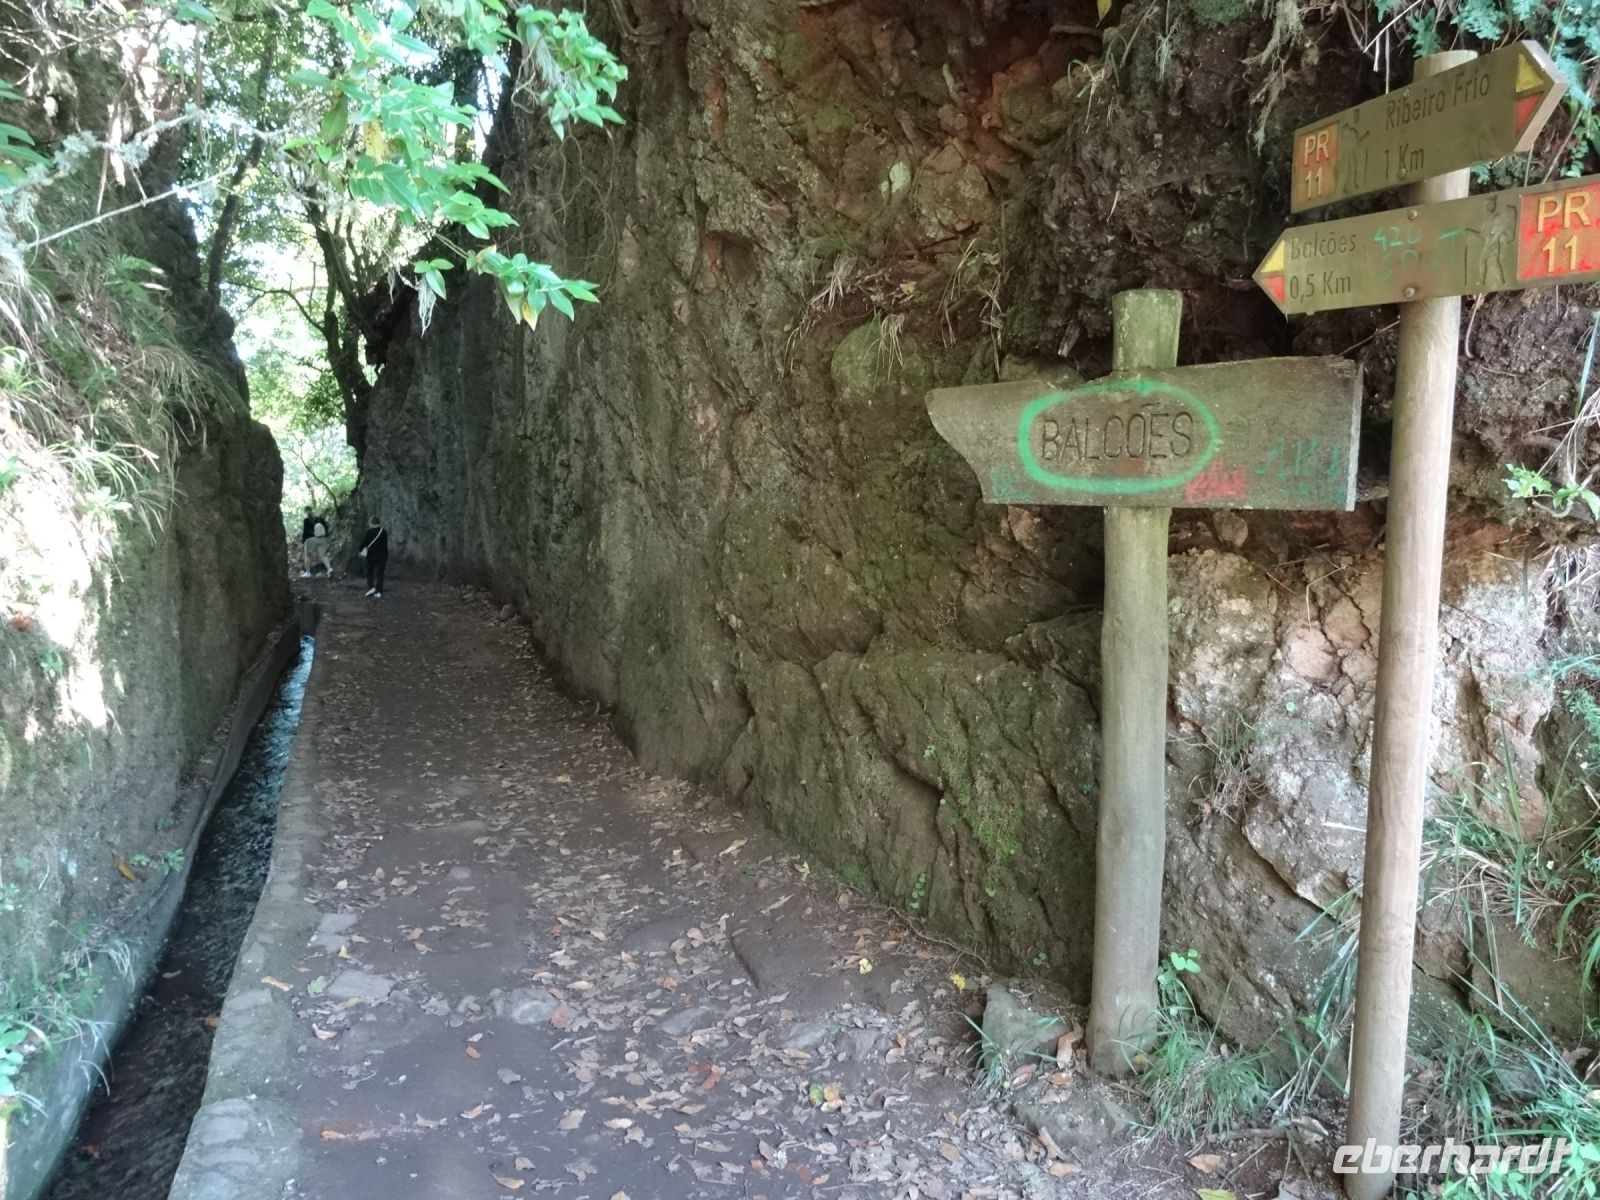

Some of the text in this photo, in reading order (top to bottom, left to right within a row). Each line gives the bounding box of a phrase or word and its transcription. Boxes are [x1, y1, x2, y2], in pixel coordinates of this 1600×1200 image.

[1386, 72, 1490, 130] Ribeiro Frio
[1304, 130, 1329, 165] PR
[1399, 144, 1425, 173] Km
[1304, 167, 1323, 199] 11
[1537, 191, 1591, 233] PR
[1290, 232, 1356, 261] Balcões
[1542, 234, 1578, 273] 11
[1289, 271, 1351, 302] 0,5 Km
[1041, 402, 1194, 461] BALCÕES
